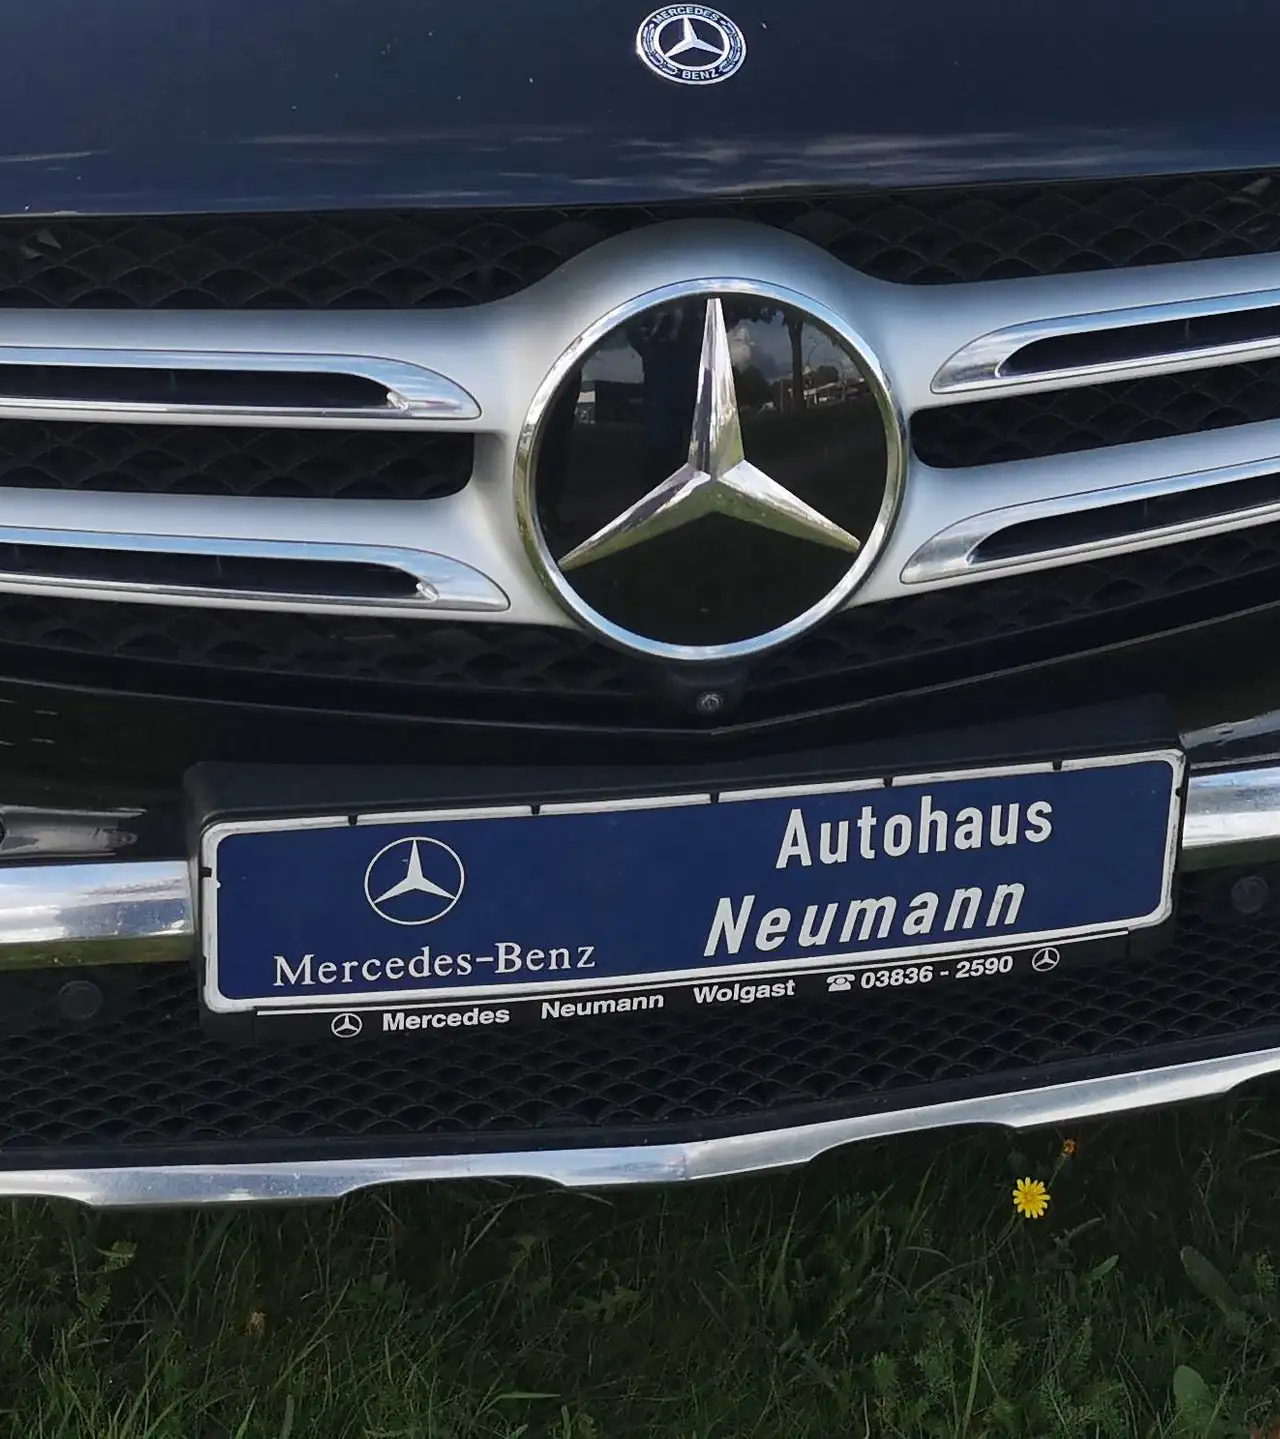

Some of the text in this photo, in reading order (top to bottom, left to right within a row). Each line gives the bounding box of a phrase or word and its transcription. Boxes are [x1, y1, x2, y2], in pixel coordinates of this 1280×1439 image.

[651, 6, 720, 24] MERCEDES
[682, 68, 720, 80] BENZ
[775, 795, 1053, 869] Autohaus
[703, 882, 1026, 958] Neumann
[272, 941, 596, 987] Mercedes-Benz
[382, 1007, 510, 1032] Mercedes
[541, 994, 665, 1019] Neumann
[693, 979, 796, 1004] Wolgast
[861, 965, 933, 990] 03836
[956, 955, 1014, 979] 2590
